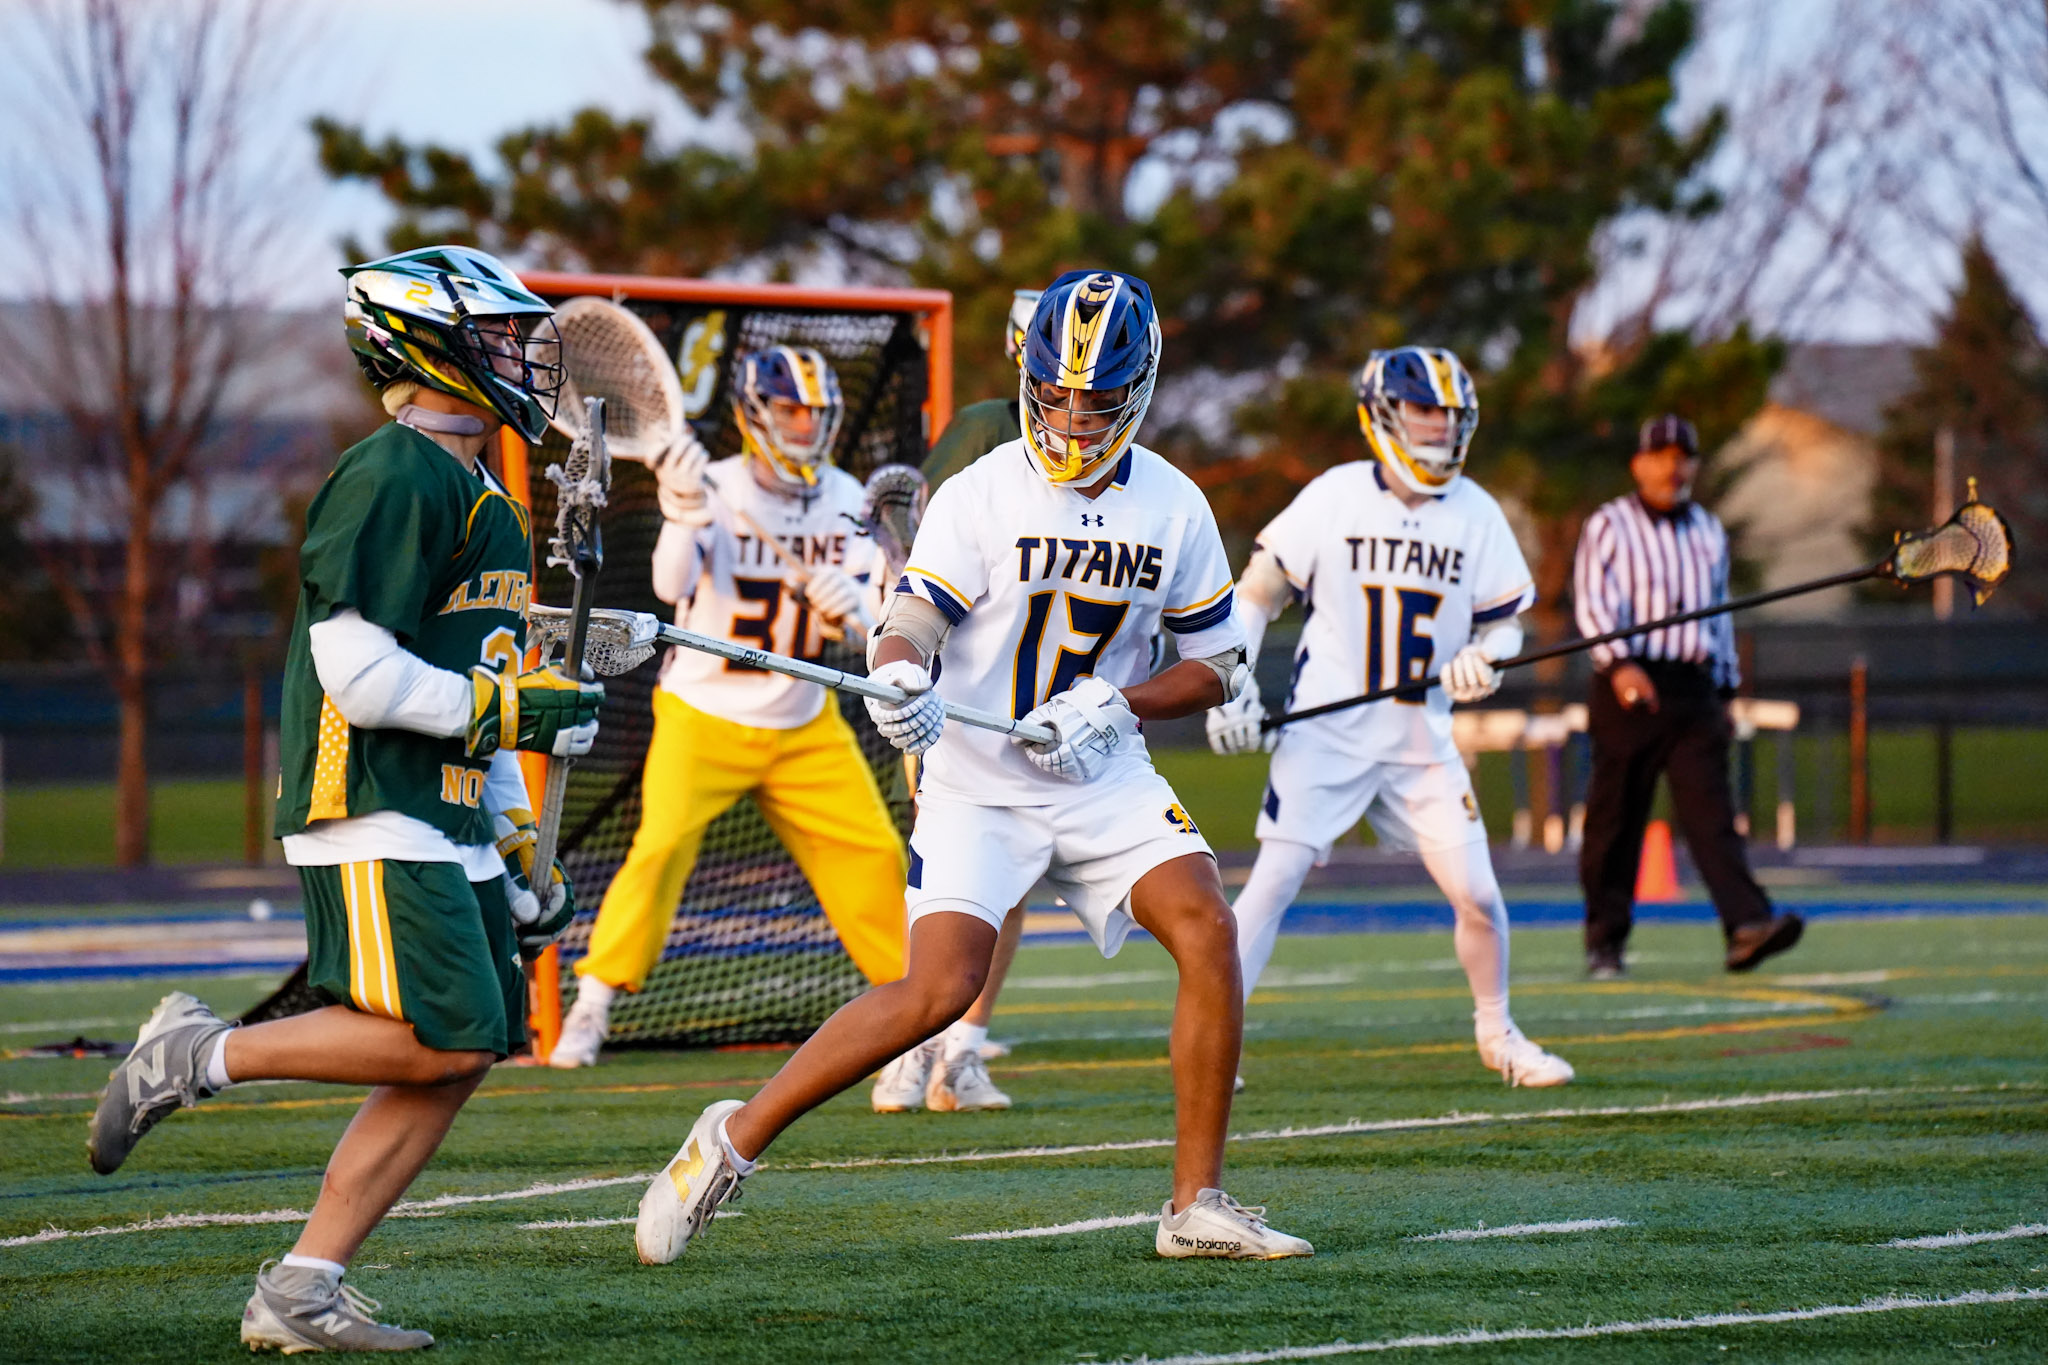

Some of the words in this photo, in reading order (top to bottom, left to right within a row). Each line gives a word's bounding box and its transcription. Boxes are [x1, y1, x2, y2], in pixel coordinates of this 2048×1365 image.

[1015, 536, 1163, 591] TITANS
[1344, 537, 1464, 584] TITANS
[1361, 583, 1445, 706] 16
[440, 763, 489, 809] NO
[1171, 1234, 1194, 1248] new
[1196, 1237, 1241, 1251] balance
